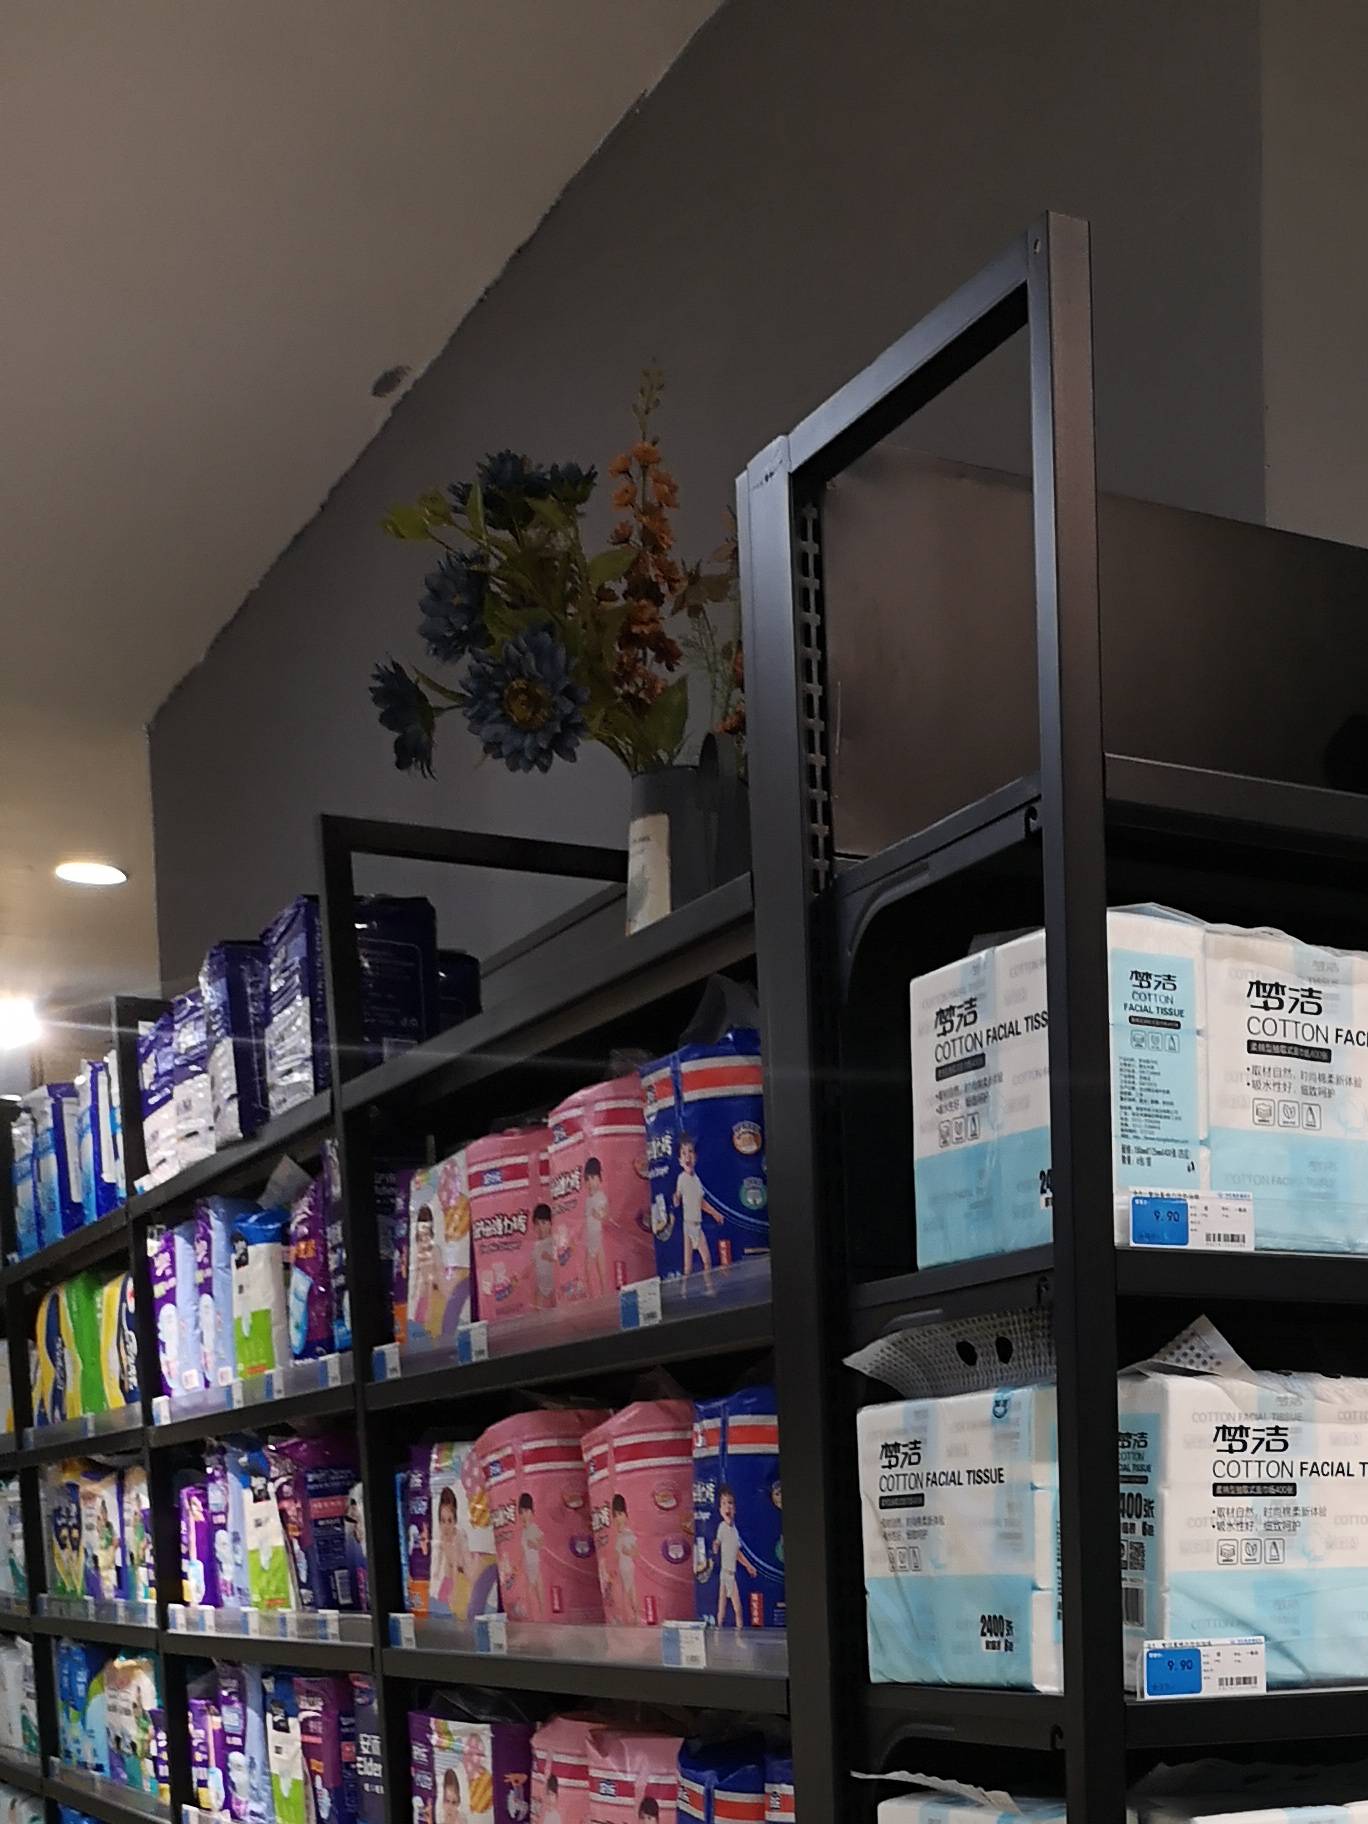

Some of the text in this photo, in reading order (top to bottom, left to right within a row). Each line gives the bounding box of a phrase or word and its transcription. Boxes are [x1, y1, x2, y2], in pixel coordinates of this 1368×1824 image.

[1129, 970, 1176, 991] 梦洁
[1123, 1002, 1184, 1018] FACIAL TISSUE
[1132, 991, 1174, 1005] COTTON
[1247, 980, 1323, 1016] 梦洁
[934, 996, 978, 1037] 梦洁
[934, 1019, 1022, 1063] COTTON FACIAL
[1247, 1016, 1329, 1044] COTTON
[1154, 1210, 1181, 1222] 9.90
[1213, 1424, 1289, 1454] 梦洁
[879, 1440, 921, 1469] 梦洁
[879, 1468, 1005, 1493] COTTON FACIAL TISSUE
[1212, 1460, 1294, 1479] COTTON
[1300, 1461, 1354, 1477] FACIAL
[1167, 1659, 1193, 1671] 9.90
